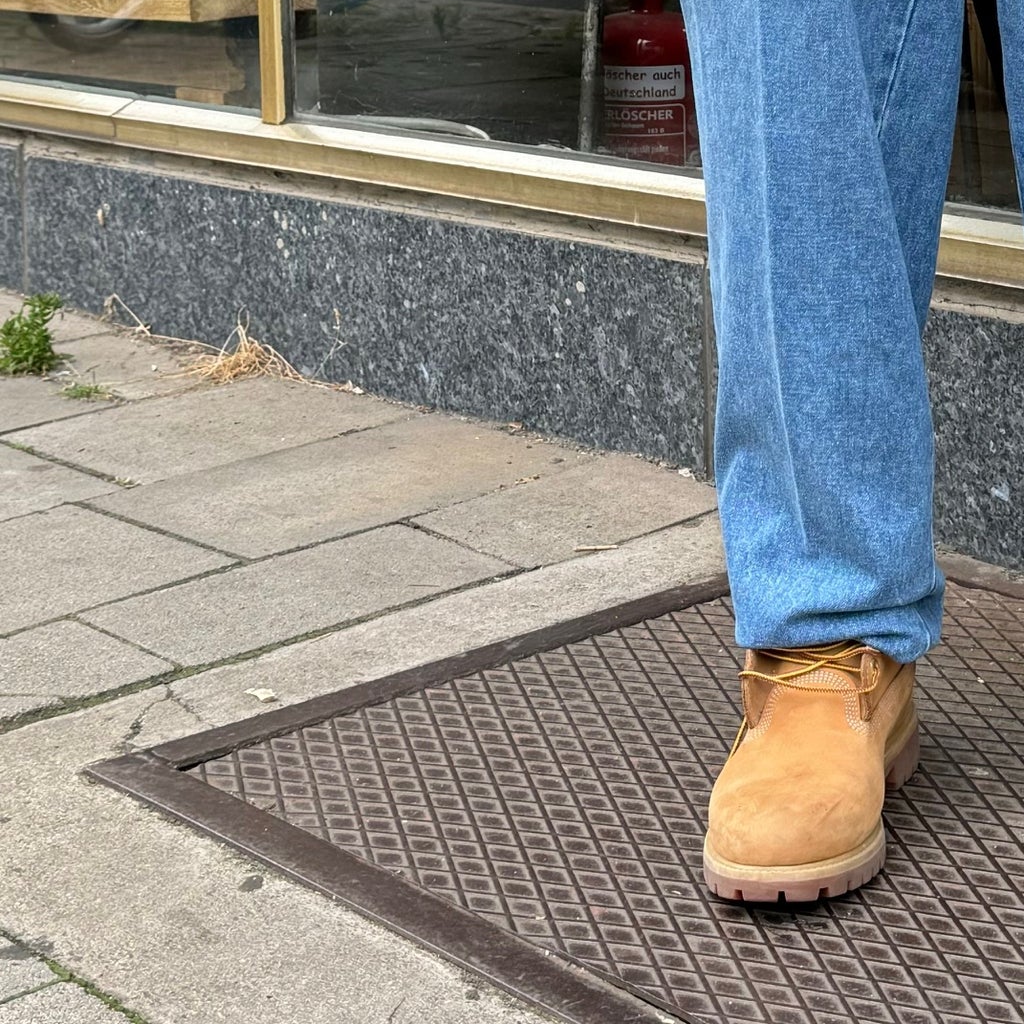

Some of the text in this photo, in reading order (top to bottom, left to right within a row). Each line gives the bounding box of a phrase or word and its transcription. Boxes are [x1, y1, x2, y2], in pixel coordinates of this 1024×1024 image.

[603, 67, 681, 82] öscher auch
[603, 85, 676, 98] Deutschland
